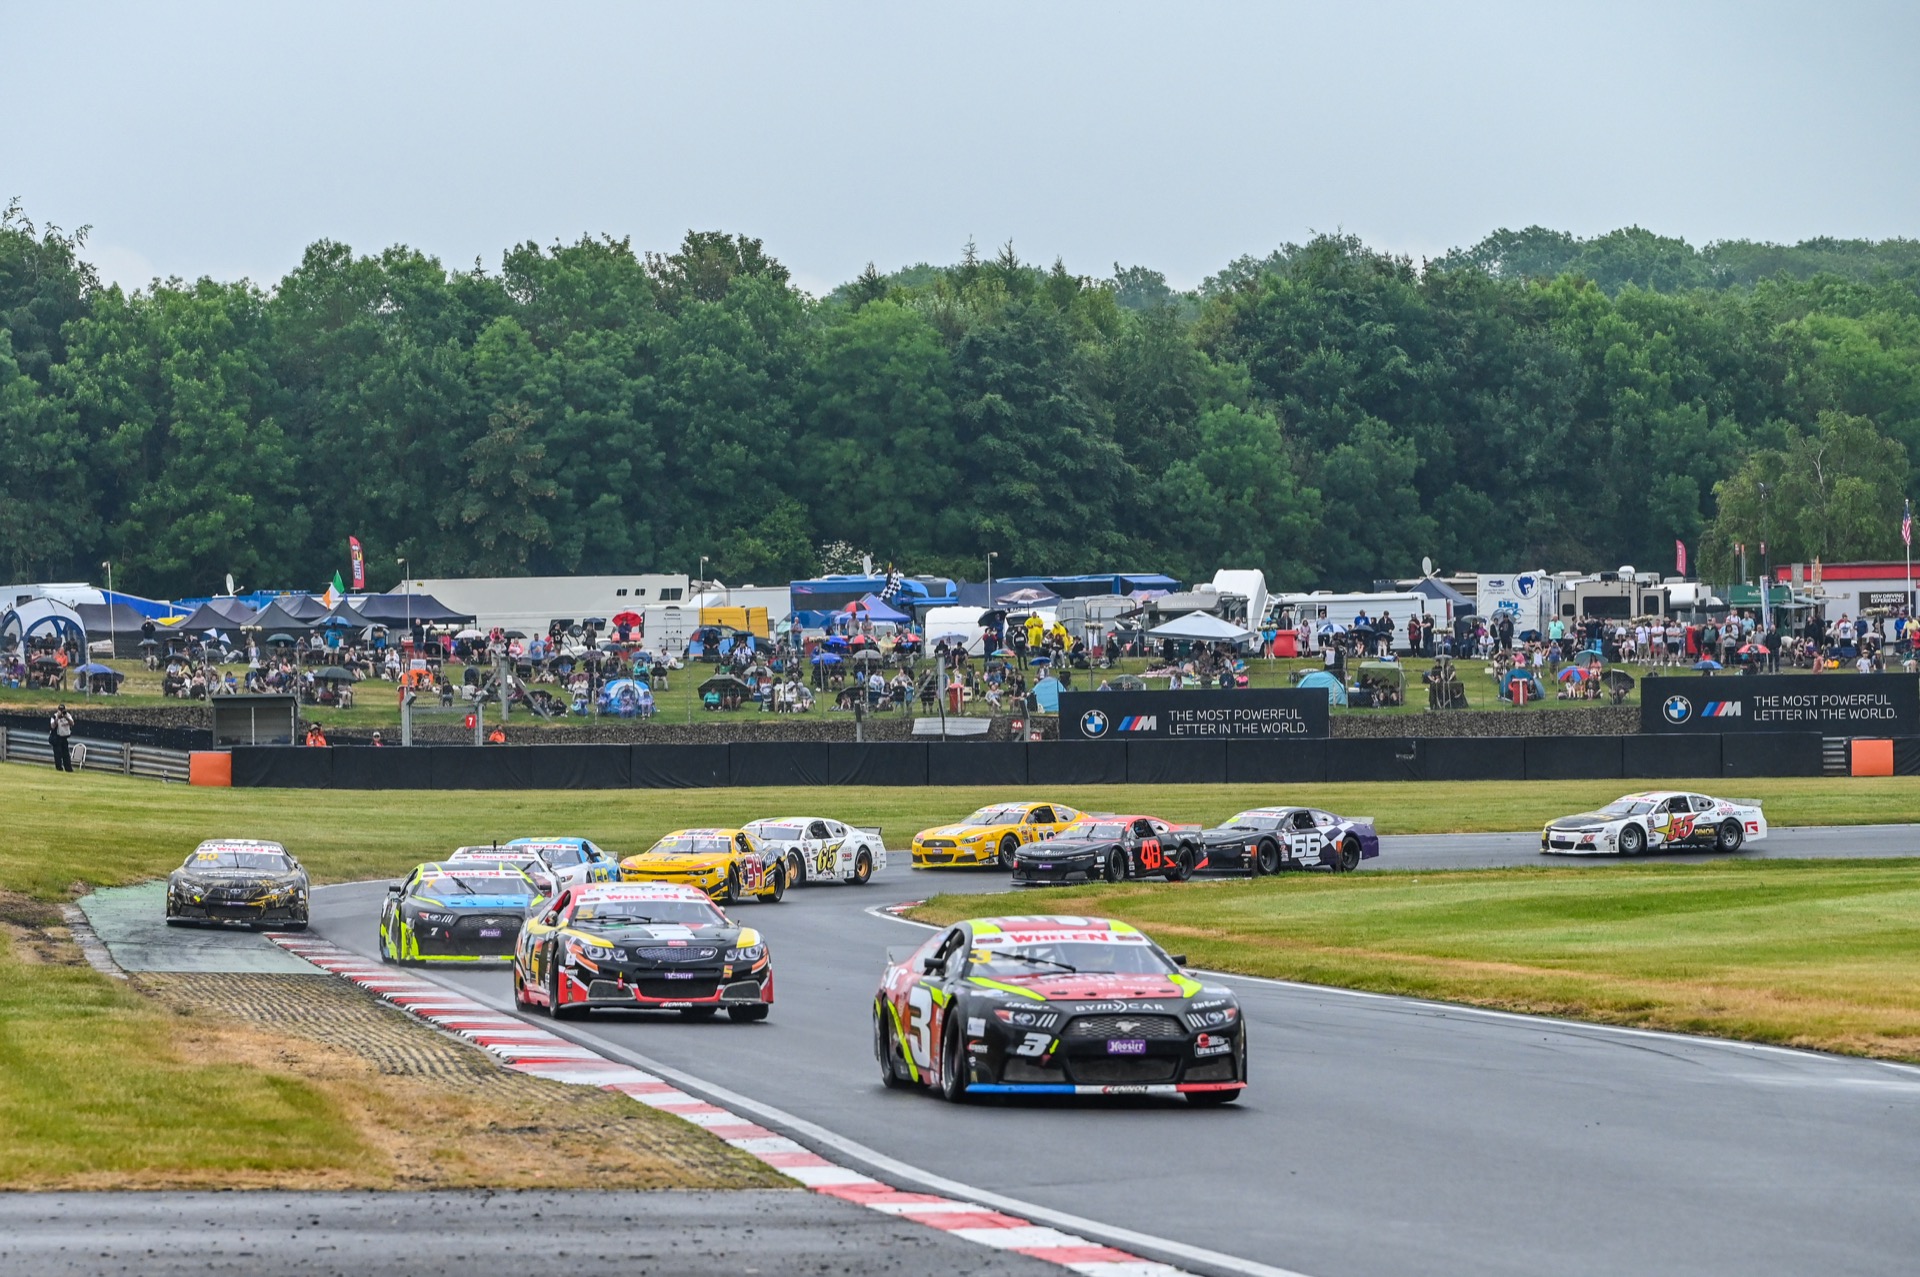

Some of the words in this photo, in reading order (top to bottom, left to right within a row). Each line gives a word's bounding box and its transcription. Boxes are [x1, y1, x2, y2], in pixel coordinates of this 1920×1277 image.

[1753, 696, 1780, 707] THE
[1783, 695, 1819, 707] MOST
[1822, 694, 1892, 706] POWERFUL
[1168, 710, 1193, 721] THE
[1196, 709, 1231, 721] MOST
[1234, 708, 1302, 720] POWERFUL
[1754, 709, 1803, 721] LETTER
[1805, 708, 1818, 720] IN
[1820, 708, 1846, 720] THE
[1848, 707, 1898, 719] WORLD.
[468, 717, 473, 726] 7
[1169, 723, 1216, 735] LETTER
[1219, 723, 1231, 734] IN
[1233, 723, 1258, 734] THE
[1260, 722, 1308, 734] WORLD.
[1667, 814, 1697, 841] 55
[1291, 833, 1321, 858] 66
[1141, 839, 1161, 870] 48
[430, 927, 438, 936] 7
[1010, 932, 1109, 943] WHELEN
[968, 949, 992, 964] 3
[723, 965, 733, 978] 5
[908, 986, 933, 1068] 3
[1016, 1032, 1052, 1057] 3
[1109, 1040, 1144, 1052] Hoosier
